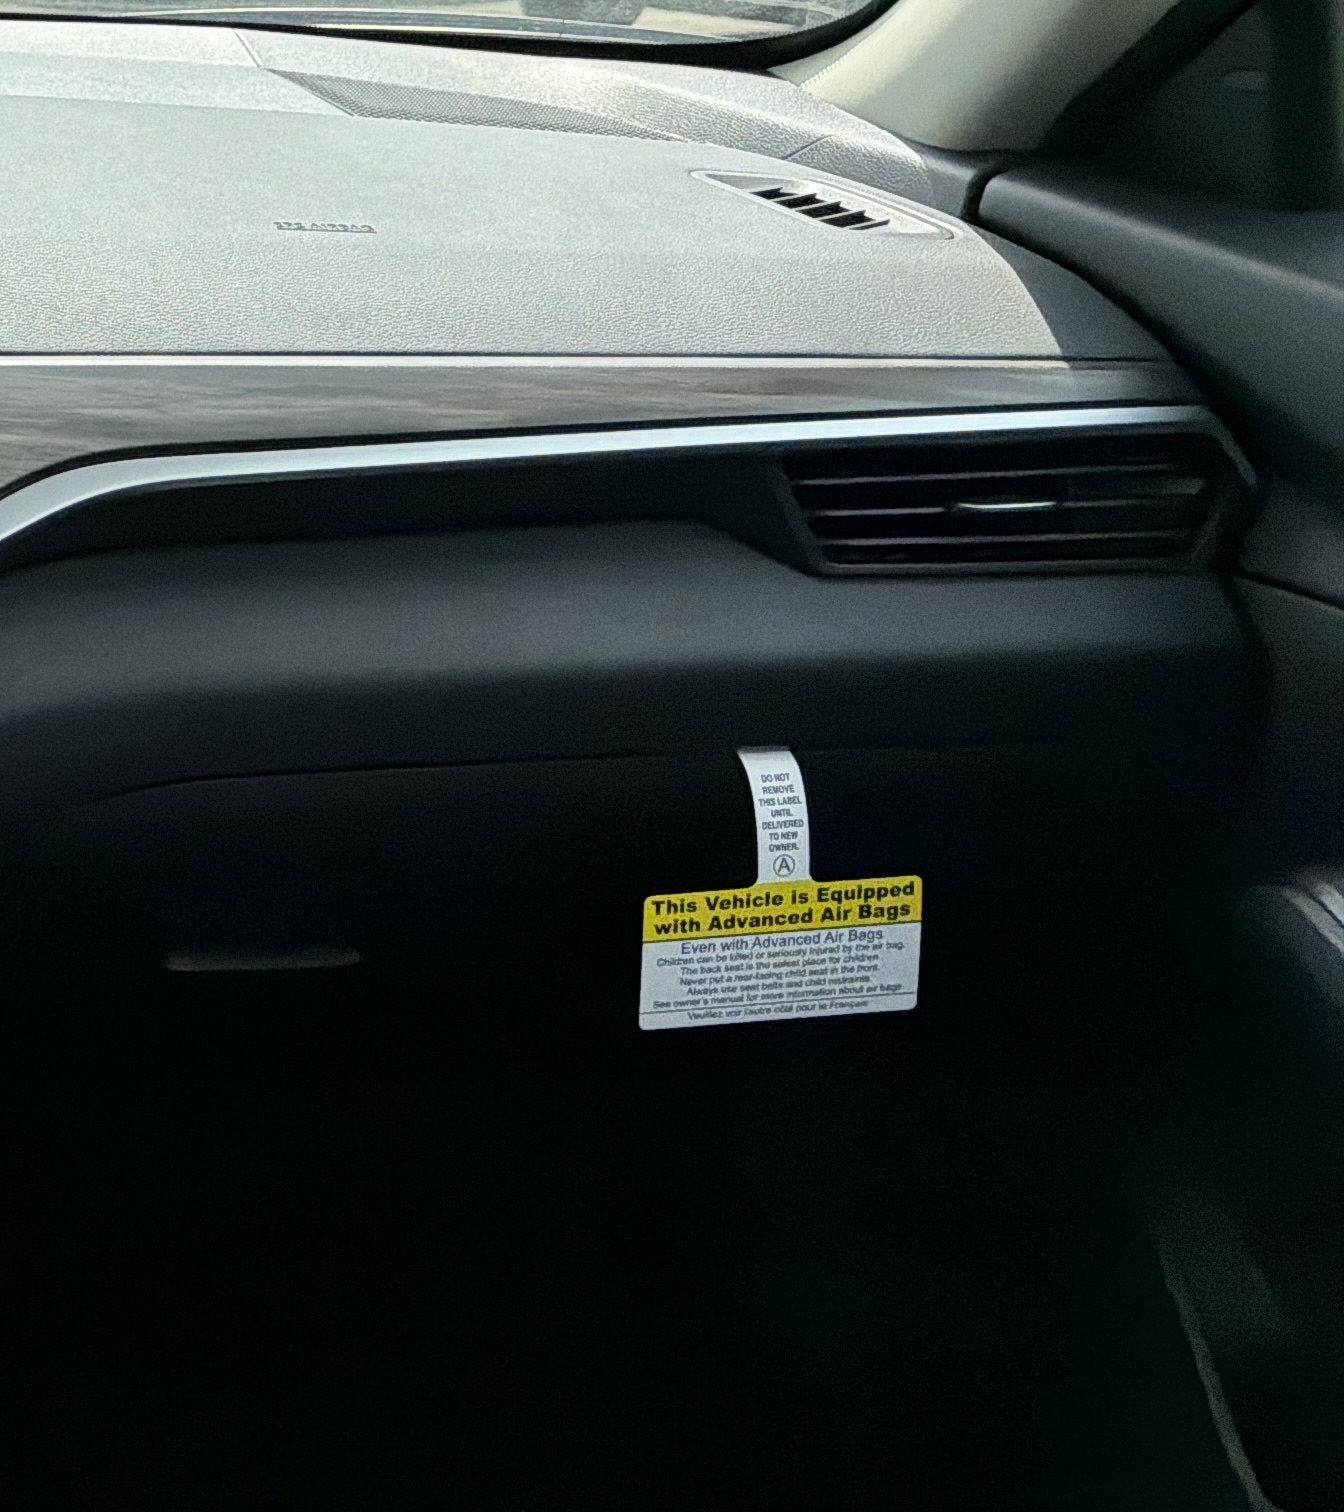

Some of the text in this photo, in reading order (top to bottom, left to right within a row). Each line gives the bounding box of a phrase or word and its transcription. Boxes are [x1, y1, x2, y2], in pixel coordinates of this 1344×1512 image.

[761, 772, 790, 783] DO NOT
[762, 784, 794, 795] REMOVE
[758, 795, 802, 807] THIS LABEL
[771, 808, 792, 818] UNTIL
[762, 819, 804, 830] DELIVERED
[769, 831, 799, 840] TO NEW
[652, 881, 915, 916] This Vehicle is Equipped
[654, 904, 911, 935] with Advanced Air Bags
[681, 929, 883, 955] Even with Advanced Air Bags
[656, 956, 694, 967] Children
[696, 956, 714, 964] can
[716, 953, 727, 962] be
[729, 951, 752, 961] killed
[767, 947, 806, 959] seriously
[809, 945, 840, 955] injured
[842, 944, 852, 954] by
[680, 966, 698, 976] The
[700, 964, 722, 974] back
[724, 963, 744, 972] seat
[802, 958, 826, 967] place
[829, 956, 840, 964] for
[680, 977, 707, 986] Never
[709, 975, 724, 985] put
[785, 968, 806, 978] child
[840, 965, 855, 974] the
[653, 1000, 671, 1009] See
[711, 993, 744, 1004] manual
[760, 992, 784, 1000] more
